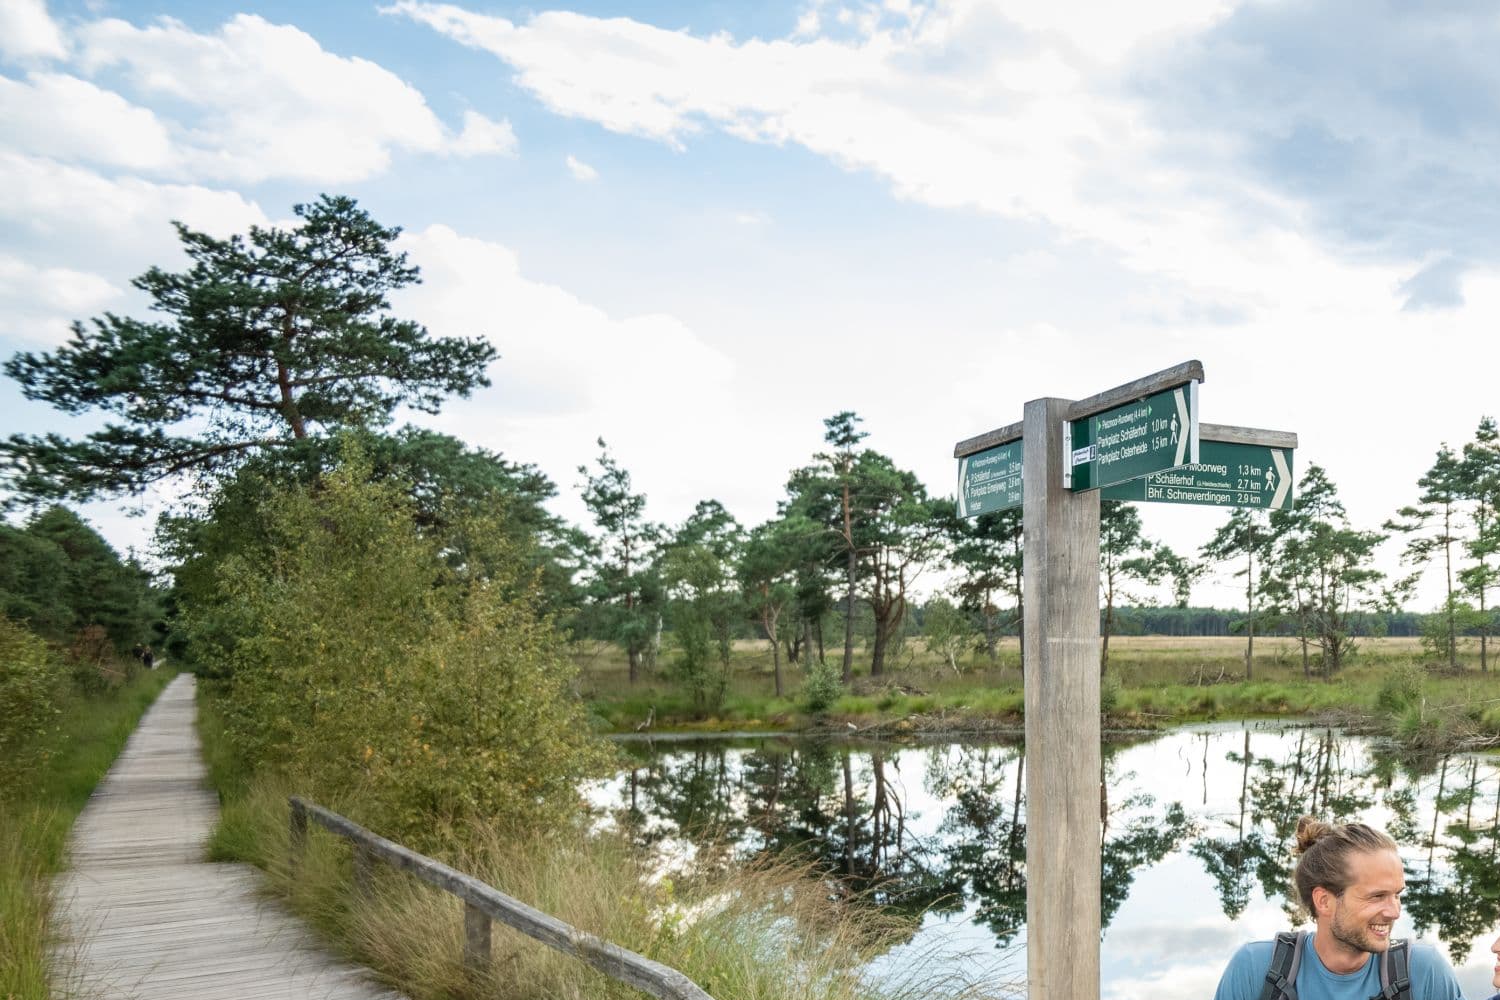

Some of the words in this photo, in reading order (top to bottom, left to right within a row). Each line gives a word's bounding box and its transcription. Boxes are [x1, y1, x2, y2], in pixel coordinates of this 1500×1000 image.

[1097, 434, 1120, 449] Parkplatz
[1120, 422, 1148, 442] Schäferhof
[1160, 418, 1168, 430] km
[1098, 450, 1120, 465] Parkplatz
[1120, 441, 1148, 459] Osterheide
[1160, 436, 1168, 448] km
[1238, 464, 1249, 476] 1,3
[1250, 465, 1261, 476] km
[1155, 473, 1194, 486] Schäferhof
[1237, 479, 1248, 491] 2,7
[1250, 479, 1261, 491] km
[1148, 487, 1164, 499] Bhf.
[1167, 488, 1231, 504] Schneverdingen
[1237, 493, 1249, 504] 2,9
[1250, 494, 1261, 504] km
